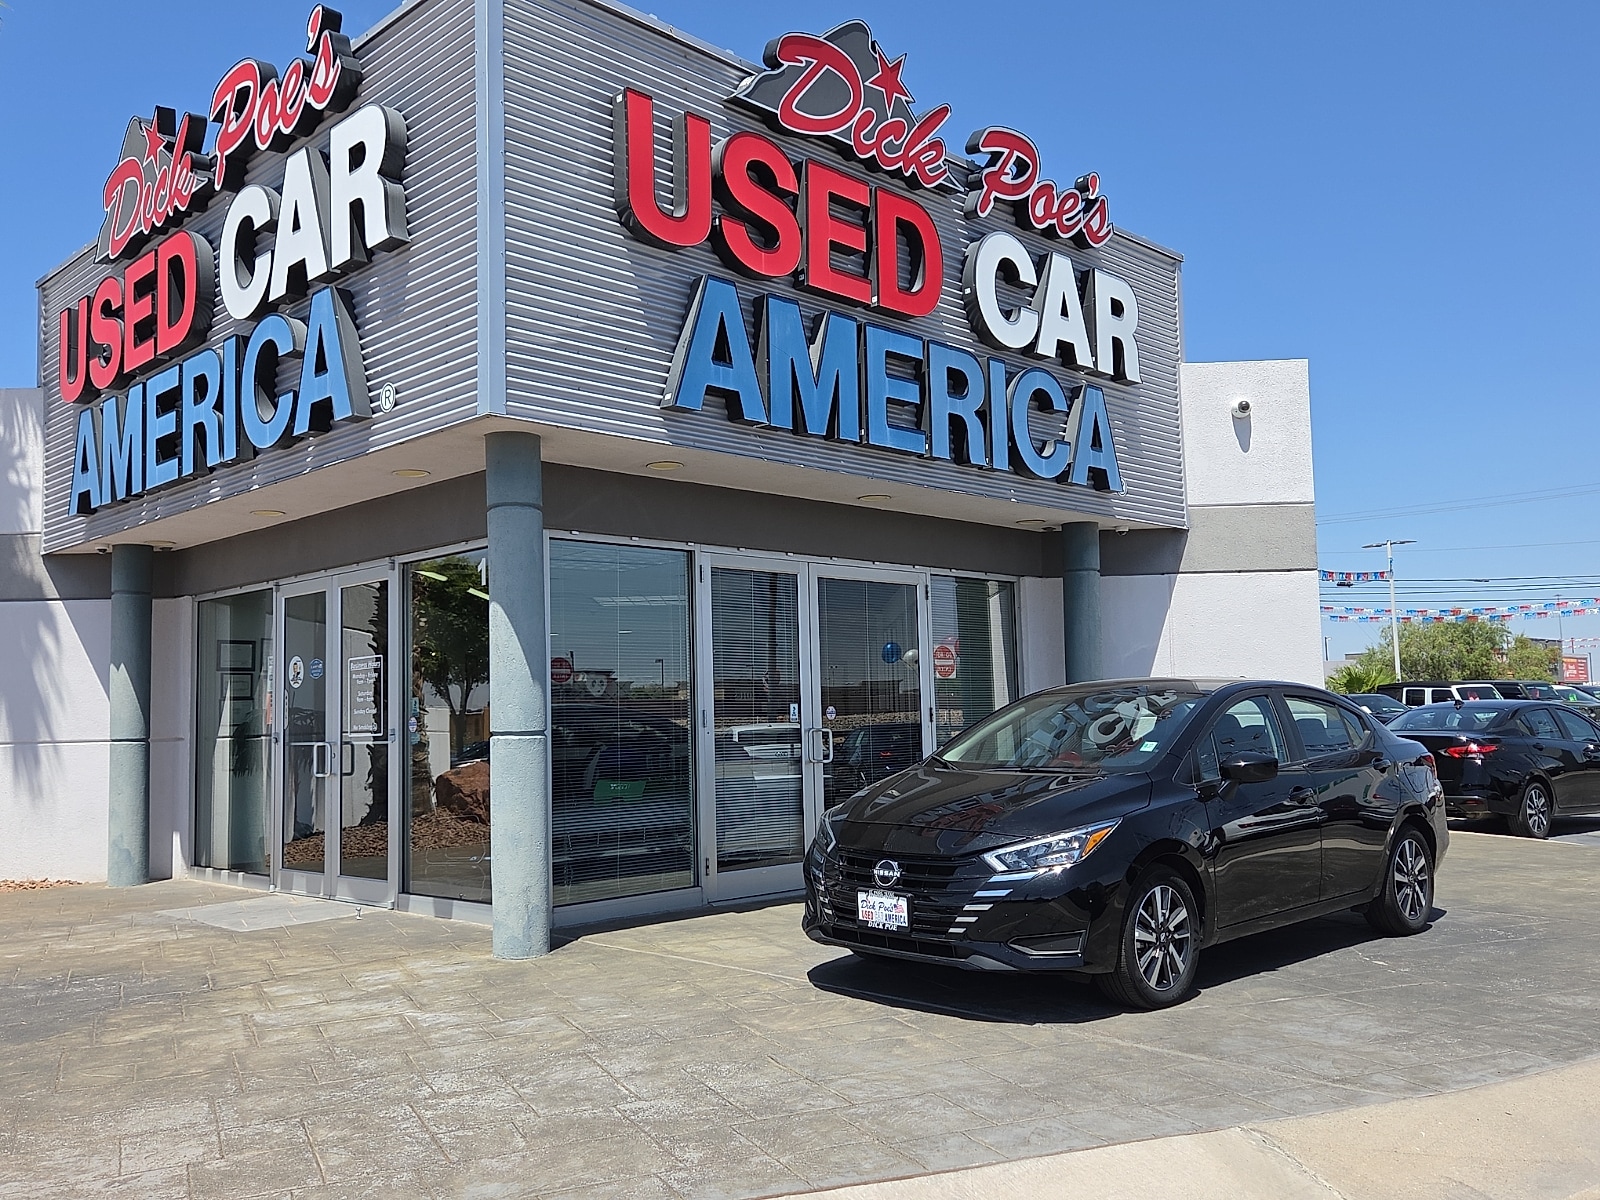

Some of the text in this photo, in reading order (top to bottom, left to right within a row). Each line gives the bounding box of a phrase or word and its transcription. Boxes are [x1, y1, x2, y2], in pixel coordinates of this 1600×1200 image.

[103, 4, 342, 260] Dick Poe's
[624, 87, 1143, 385] USED CAR
[776, 32, 1113, 249] Dick Poe's
[59, 103, 391, 404] USED CAR
[69, 286, 353, 517] AMERICA
[674, 275, 1123, 493] AMERICA
[861, 899, 876, 910] Dick
[861, 910, 874, 920] USED
[885, 913, 906, 925] AMERICA
[868, 921, 898, 931] DICK POE
[873, 868, 901, 878] NISSAN
